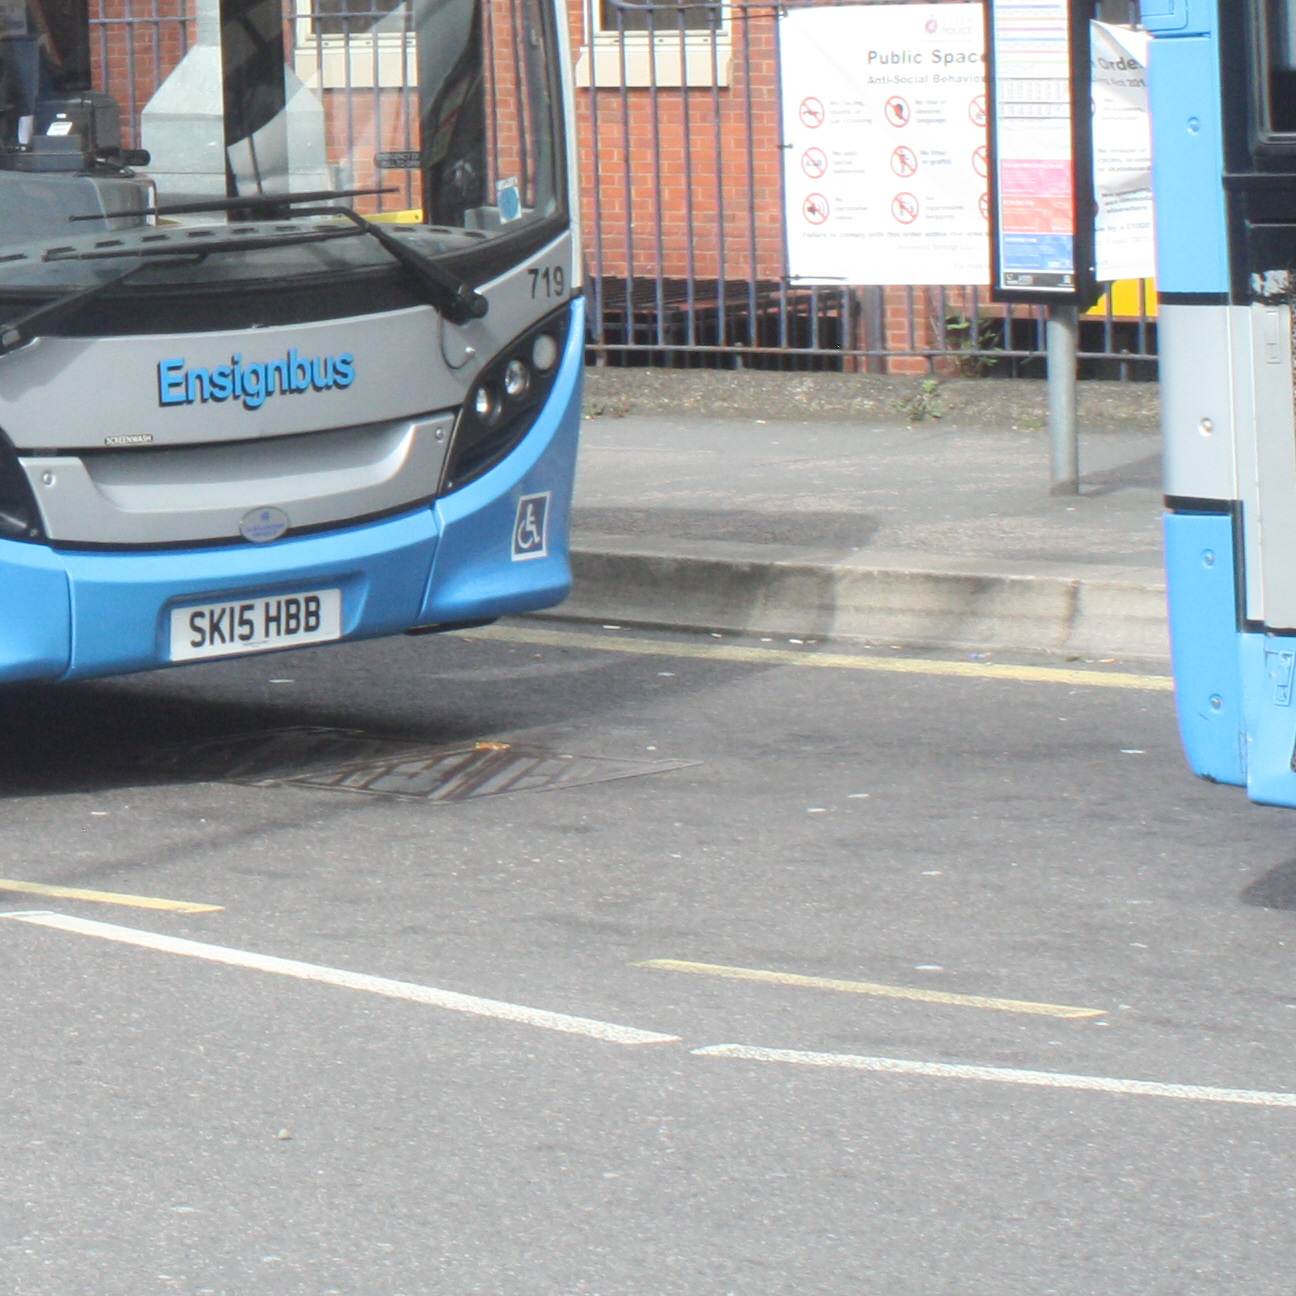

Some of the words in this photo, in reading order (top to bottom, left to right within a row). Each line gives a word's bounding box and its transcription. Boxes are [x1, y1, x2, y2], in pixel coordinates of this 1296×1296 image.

[867, 50, 924, 65] Public
[1098, 57, 1143, 71] Orde
[868, 74, 928, 85] Anti-Social
[933, 73, 986, 83] Behavio
[528, 266, 565, 299] 719
[158, 347, 355, 411] Ensignbus
[189, 604, 256, 648] SK15
[264, 595, 321, 638] HBB
